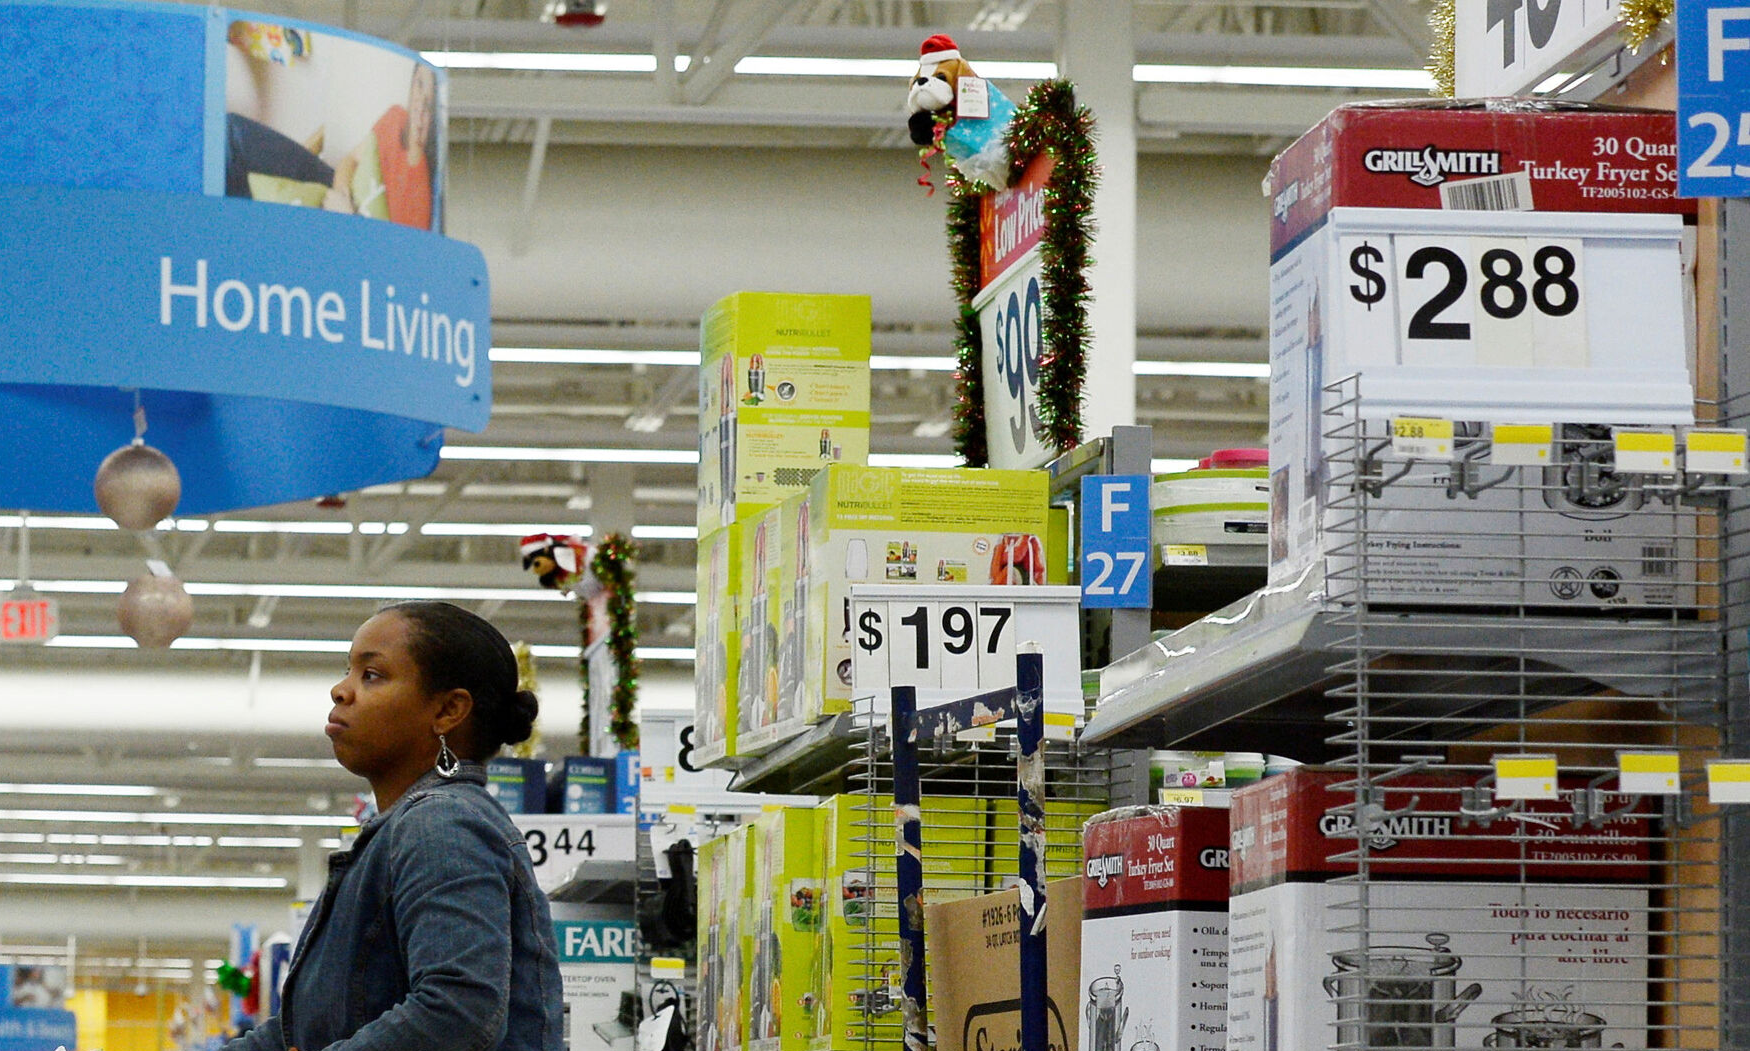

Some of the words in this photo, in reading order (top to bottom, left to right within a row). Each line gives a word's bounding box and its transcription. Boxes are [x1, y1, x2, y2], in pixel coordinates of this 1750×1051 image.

[1364, 146, 1500, 182] GRILLSMITH
[1593, 137, 1619, 156] 30
[1624, 137, 1678, 160] Quar
[1519, 160, 1590, 186] Turkey
[1596, 161, 1648, 185] Fryer
[1655, 163, 1678, 182] Se
[160, 257, 346, 343] Home
[360, 279, 475, 387] Living
[1101, 482, 1131, 533] F
[1084, 551, 1146, 596] 27
[1, 600, 49, 639] EXIT
[1148, 857, 1163, 877] Fryer
[1164, 857, 1174, 873] Set
[1200, 926, 1220, 936] Olla
